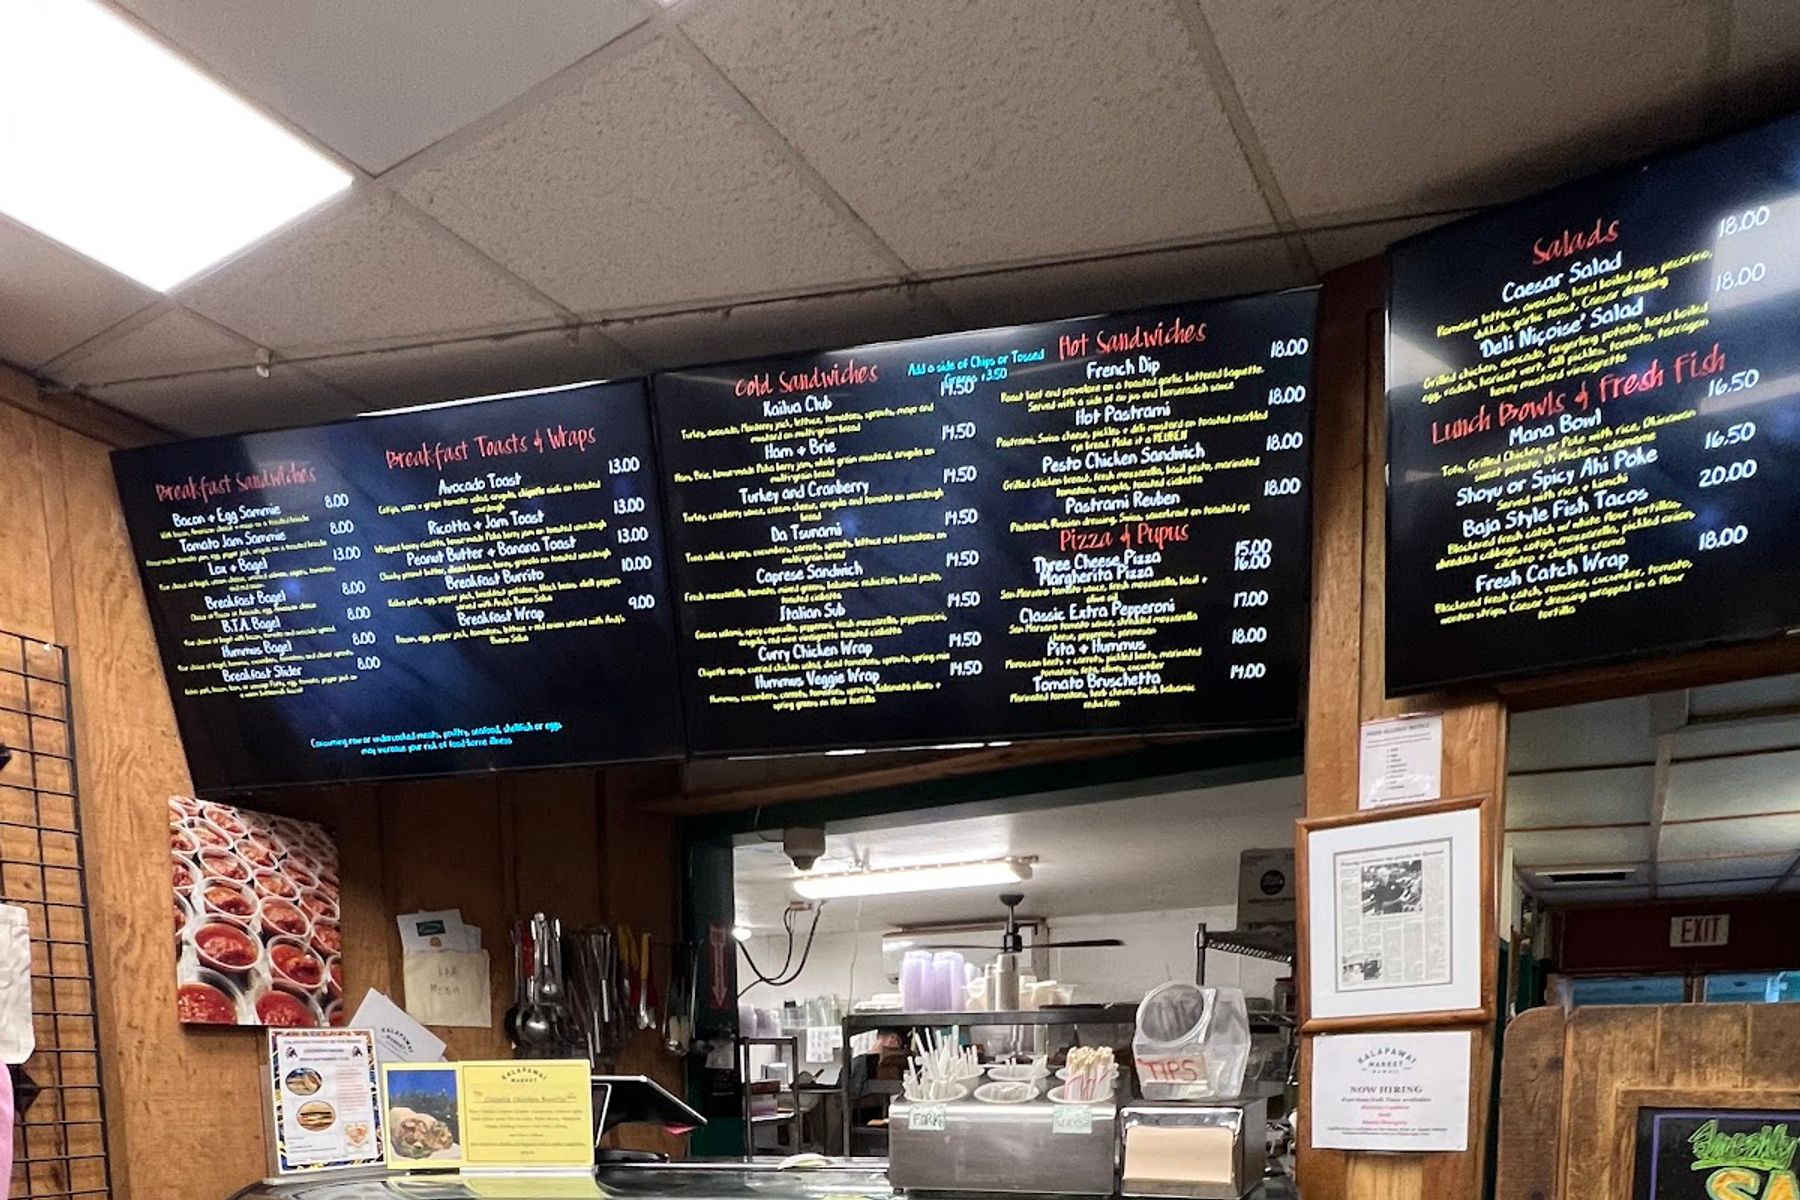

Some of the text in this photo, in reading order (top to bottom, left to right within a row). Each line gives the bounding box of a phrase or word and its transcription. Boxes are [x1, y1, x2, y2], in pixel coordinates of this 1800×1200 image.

[1718, 206, 1770, 238] 18.00
[1531, 218, 1621, 266] Salads
[1502, 250, 1623, 304] Caesar Salad
[1714, 262, 1766, 292] 18.00
[1058, 318, 1207, 361] Hot Sandwiches
[1479, 331, 1515, 360] Deli
[1590, 296, 1644, 326] Salad
[1270, 338, 1309, 358] 18.00
[734, 360, 879, 398] Cold Sandwiches
[1086, 355, 1160, 380] French Dip
[940, 380, 974, 397] 14.50
[1432, 406, 1491, 446] Lunch
[1498, 390, 1566, 428] Bowls
[1599, 359, 1664, 401] Fresh
[1673, 342, 1726, 385] Fish
[1706, 368, 1760, 400] 16.50
[763, 395, 832, 418] Kailua Club
[1076, 402, 1171, 426] Hot Pastrami
[1508, 408, 1602, 447] Mana Bowl
[1704, 422, 1756, 450] 16.50
[386, 443, 468, 471] Breakfast
[474, 433, 527, 458] Toasts
[548, 424, 596, 452] Wraps
[764, 442, 793, 460] Ham
[809, 439, 836, 456] Brie
[1042, 443, 1205, 474] Pesto Chicken Sandwich
[608, 456, 640, 474] 13.00
[1455, 446, 1658, 507] Shoyu or Spicy Ahi Poke
[1698, 458, 1758, 487] 20.00
[155, 462, 318, 504] Breakfast Sandwiches
[438, 472, 522, 496] Avocado Toast
[738, 478, 869, 506] Turkey and Cranberry
[324, 494, 350, 508] 8.00
[1066, 490, 1180, 515] Pastrami Reuben
[172, 512, 206, 528] Bacon
[216, 507, 239, 525] Egg
[240, 503, 282, 518] Sammie
[428, 519, 471, 536] Ricotta
[482, 514, 509, 530] Jam
[510, 510, 544, 526] Toast
[1462, 488, 1649, 539] Baja Style Fish Tacos
[179, 538, 220, 554] Tomato
[221, 534, 244, 548] Jam
[244, 530, 286, 546] Sammie
[771, 522, 842, 543] Da Tsunami
[1060, 528, 1112, 551] Pizza
[1137, 522, 1190, 548] Pupus
[1698, 525, 1748, 550] 18.00
[332, 546, 360, 562] 13.00
[407, 548, 444, 567] Peanut
[446, 546, 484, 562] Butter
[496, 539, 540, 556] Banana
[541, 536, 576, 552] Toast
[1234, 538, 1272, 556] 15.00
[622, 556, 652, 572] 10.00
[756, 561, 863, 586] Caprese Sandwich
[1032, 549, 1162, 574] Three Cheese Pizza
[1234, 554, 1271, 571] 16.00
[1476, 552, 1630, 594] Fresh Catch Wrap
[445, 568, 544, 590] Breakfast Burrito
[1039, 566, 1154, 588] Margherita Pizza
[204, 590, 286, 610] Breakfast Bagel
[628, 594, 655, 610] 9.00
[1233, 590, 1269, 608] 17.00
[458, 607, 544, 627] Breakfast Wrap
[780, 602, 846, 622] Italian Sub
[1020, 598, 1176, 625] Classic Extra Pepperoni
[1232, 627, 1267, 644] 18.00
[758, 641, 873, 663] Curry Chicken Wrap
[1047, 641, 1075, 657] Pita
[1092, 639, 1146, 654] Hummus
[222, 665, 302, 684] Breakfast Slider
[755, 668, 880, 690] Hummus Veggie Wrap
[950, 660, 983, 677] 14.50
[1032, 672, 1162, 692] Tomato Bruschetta
[1680, 918, 1721, 944] EXIT
[1358, 1047, 1417, 1064] KALAPAWAI
[1138, 1058, 1198, 1082] TIPS
[1350, 1086, 1424, 1094] NOW HIRING
